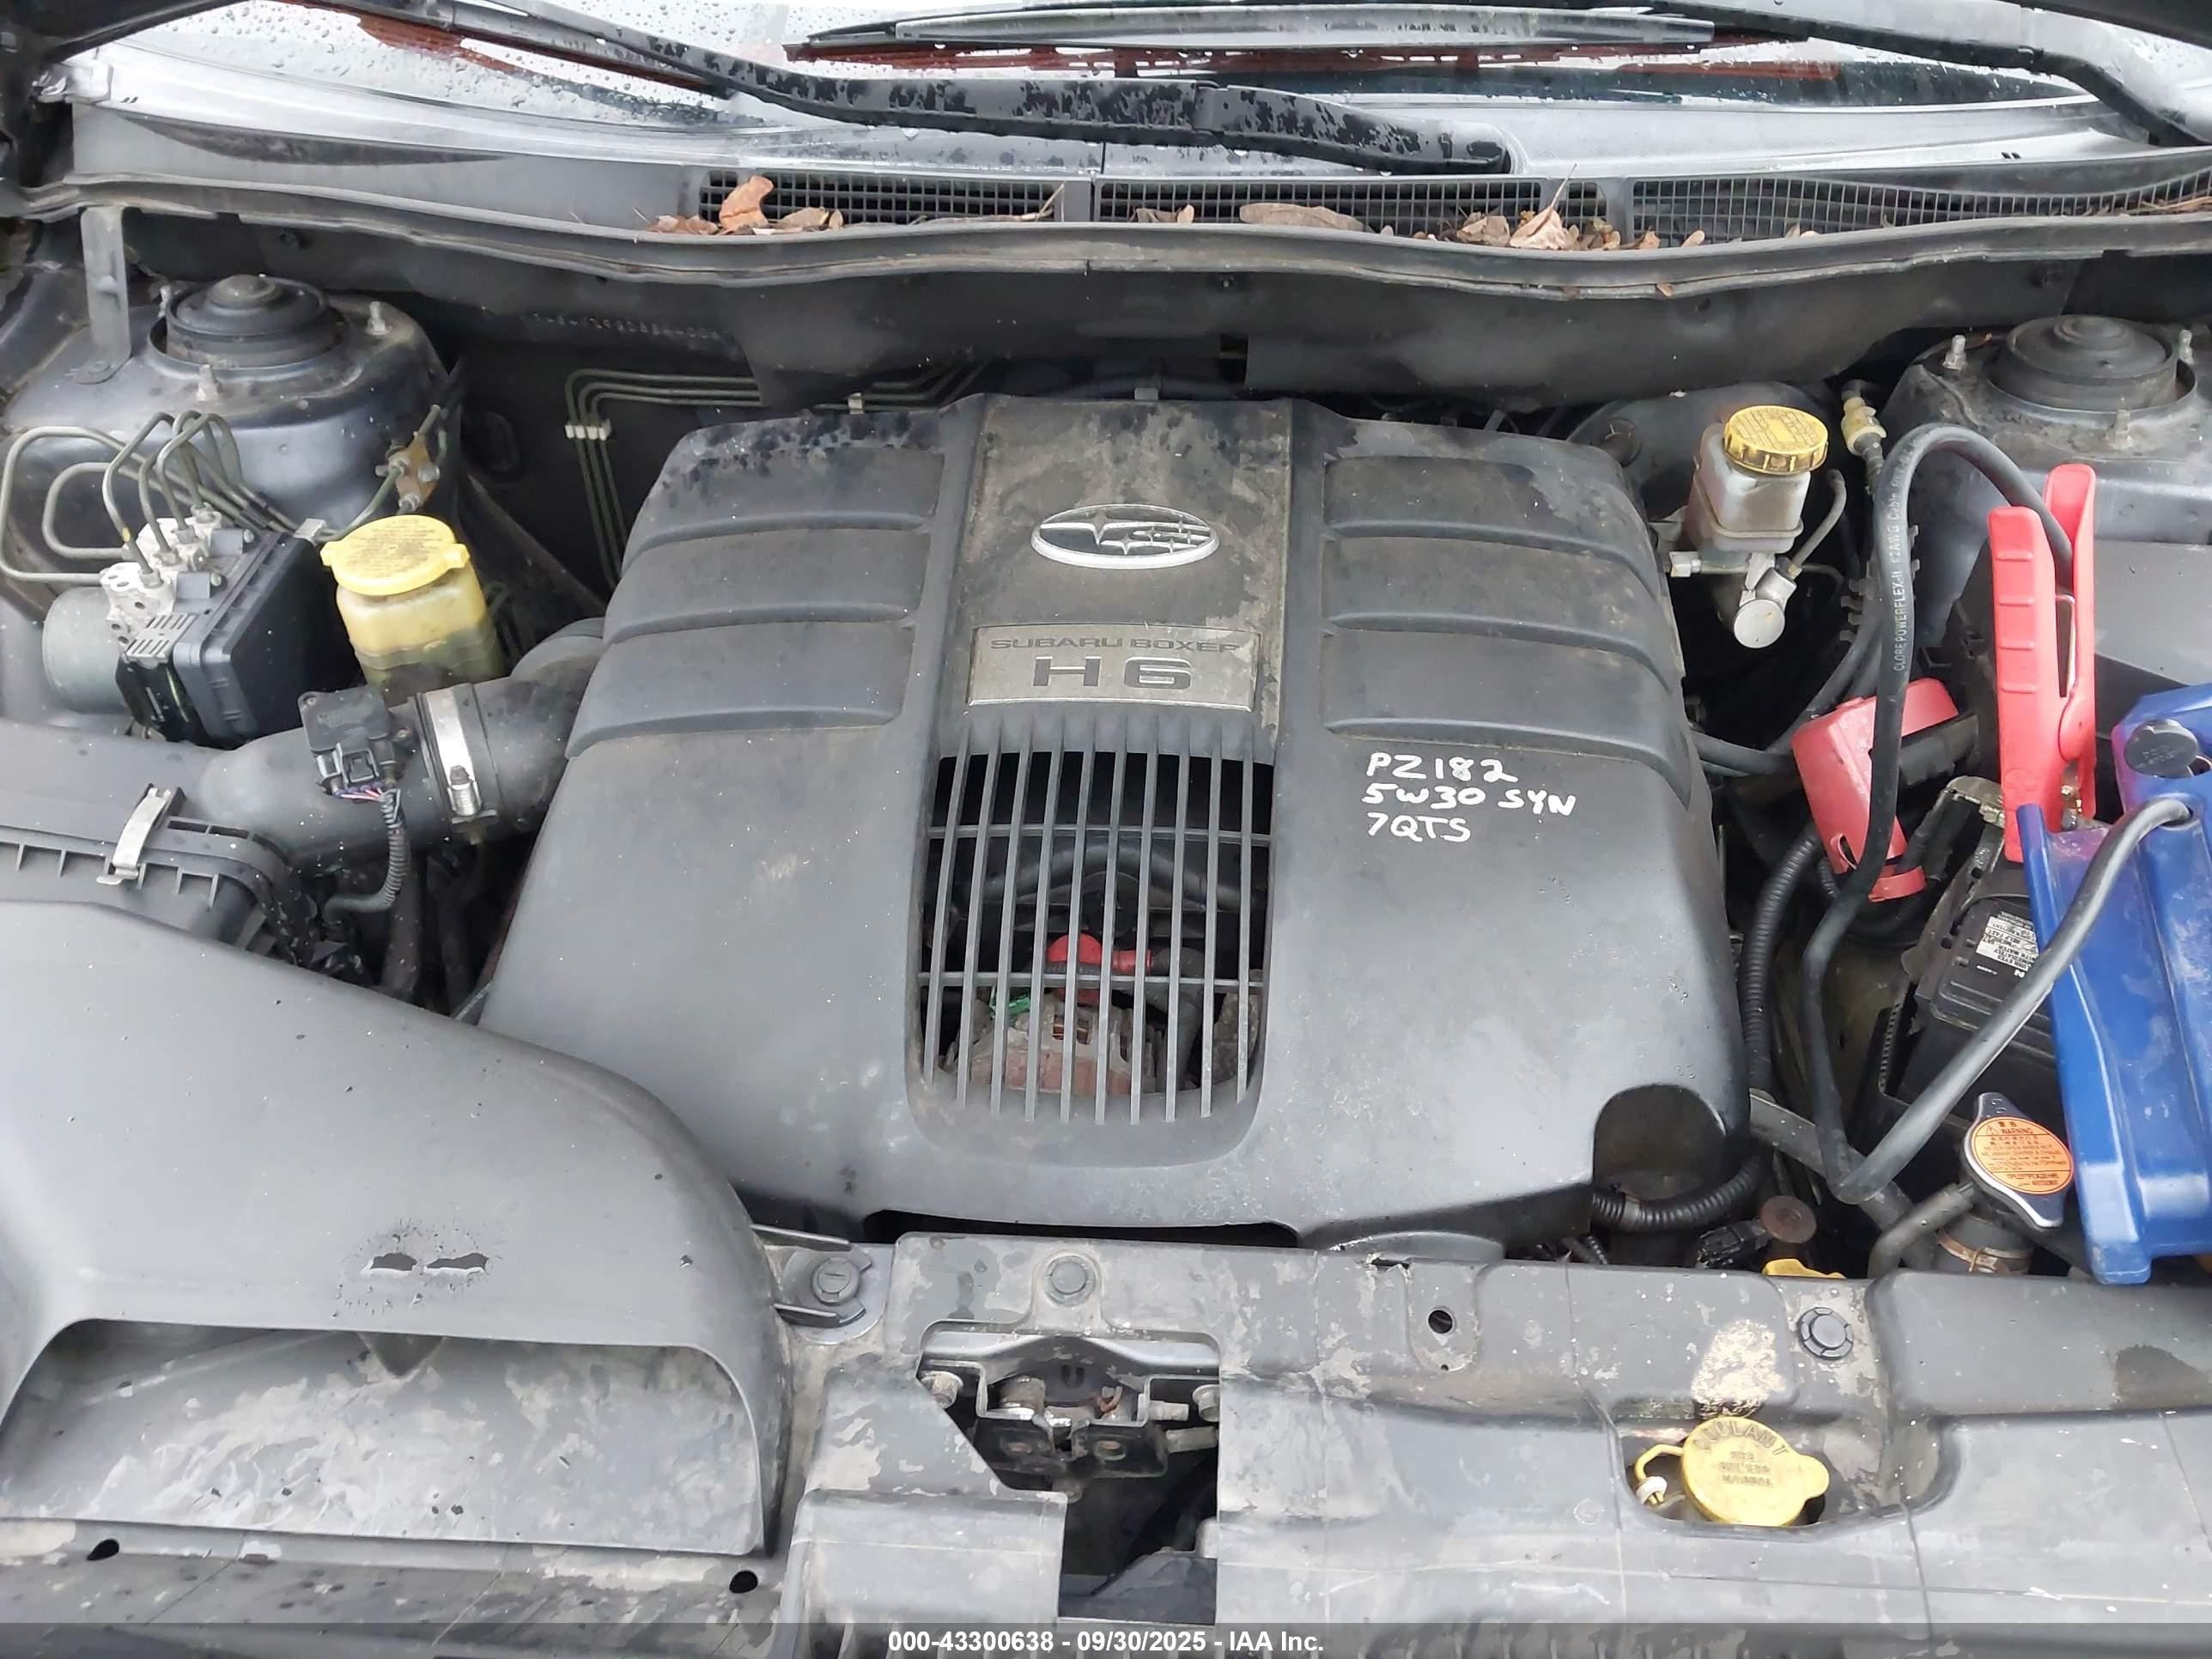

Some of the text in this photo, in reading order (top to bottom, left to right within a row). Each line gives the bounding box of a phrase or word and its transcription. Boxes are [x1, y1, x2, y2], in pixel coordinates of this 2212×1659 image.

[990, 637, 1122, 649] SUBARU
[1498, 789, 1576, 816] SYN
[1366, 811, 1471, 842] 7QTS
